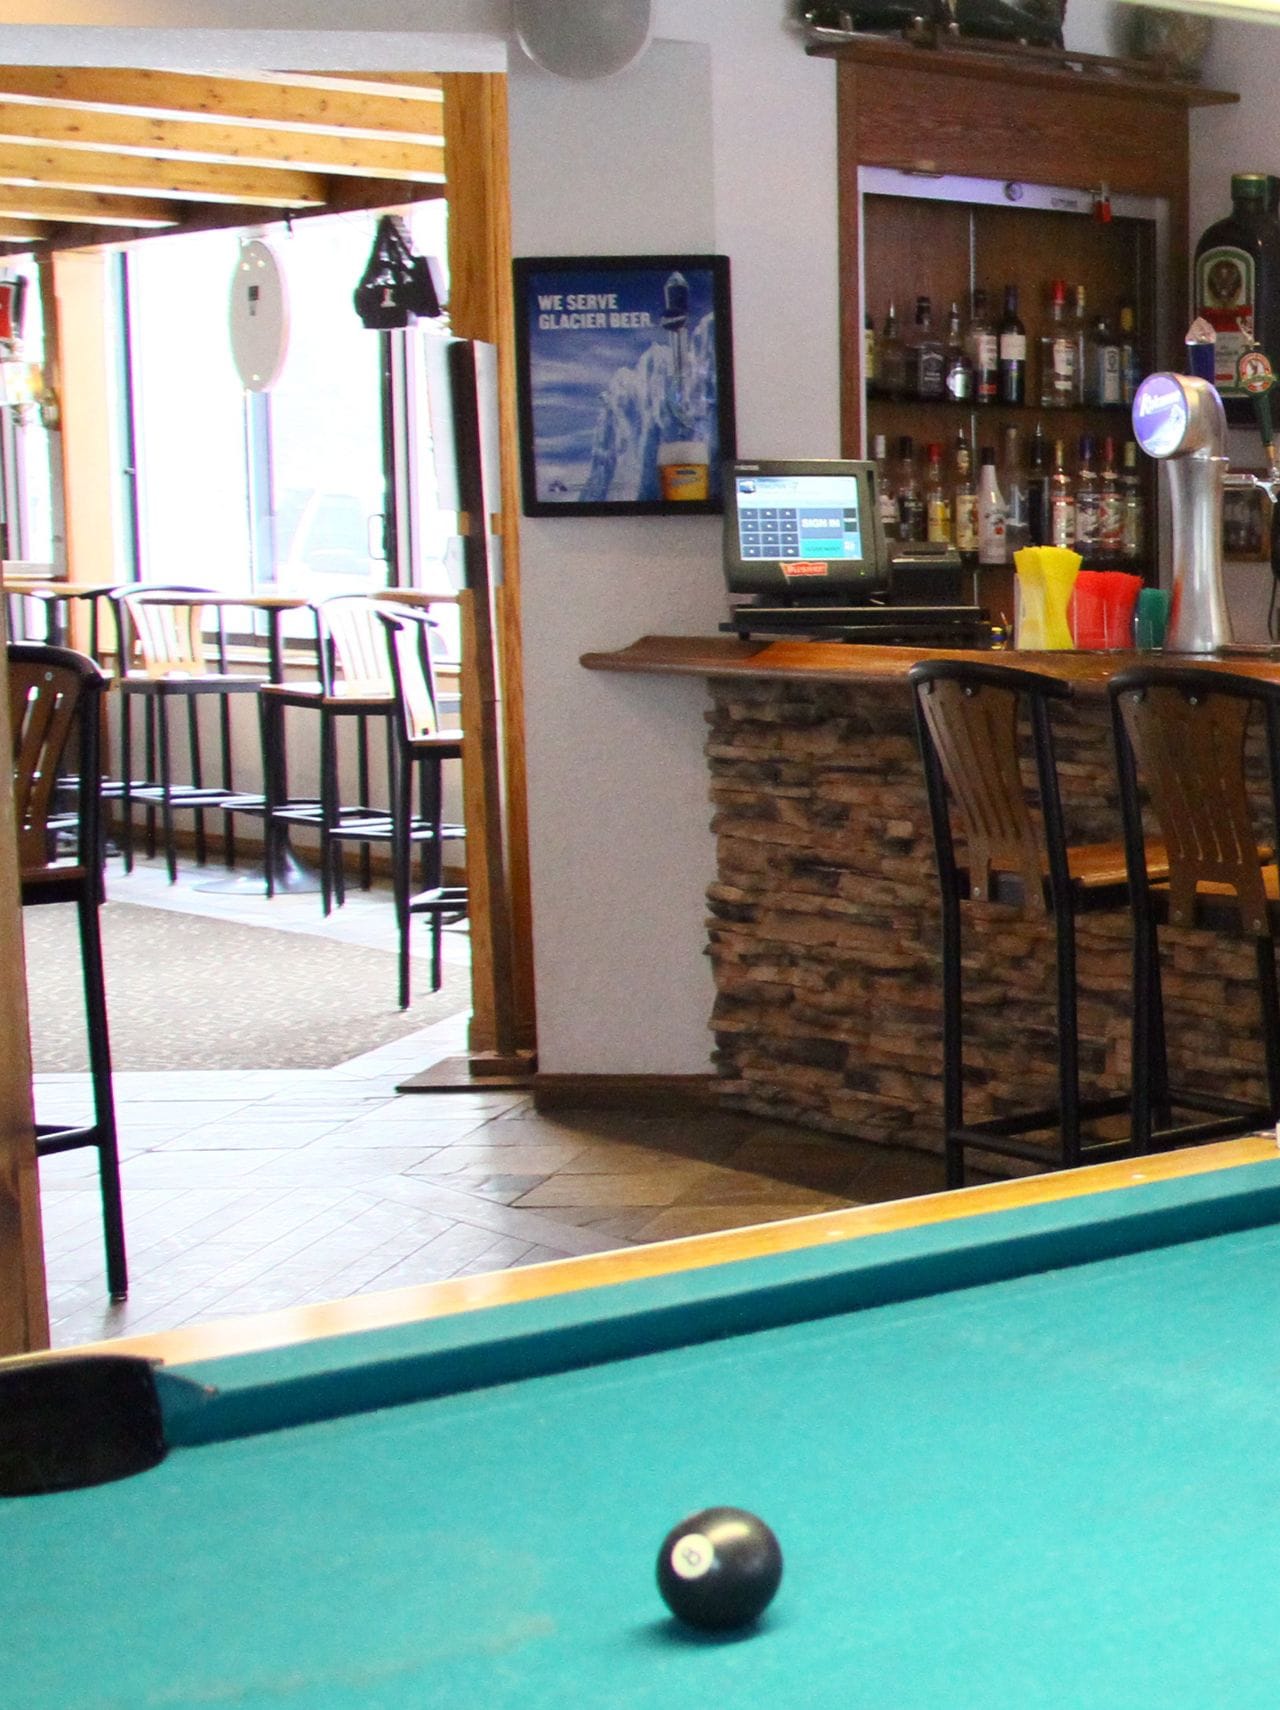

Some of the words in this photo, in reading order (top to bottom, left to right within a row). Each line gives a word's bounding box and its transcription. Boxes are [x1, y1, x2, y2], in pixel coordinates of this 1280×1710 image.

[537, 294, 563, 311] WE
[566, 293, 618, 310] SERVE
[538, 312, 606, 330] GLACIER
